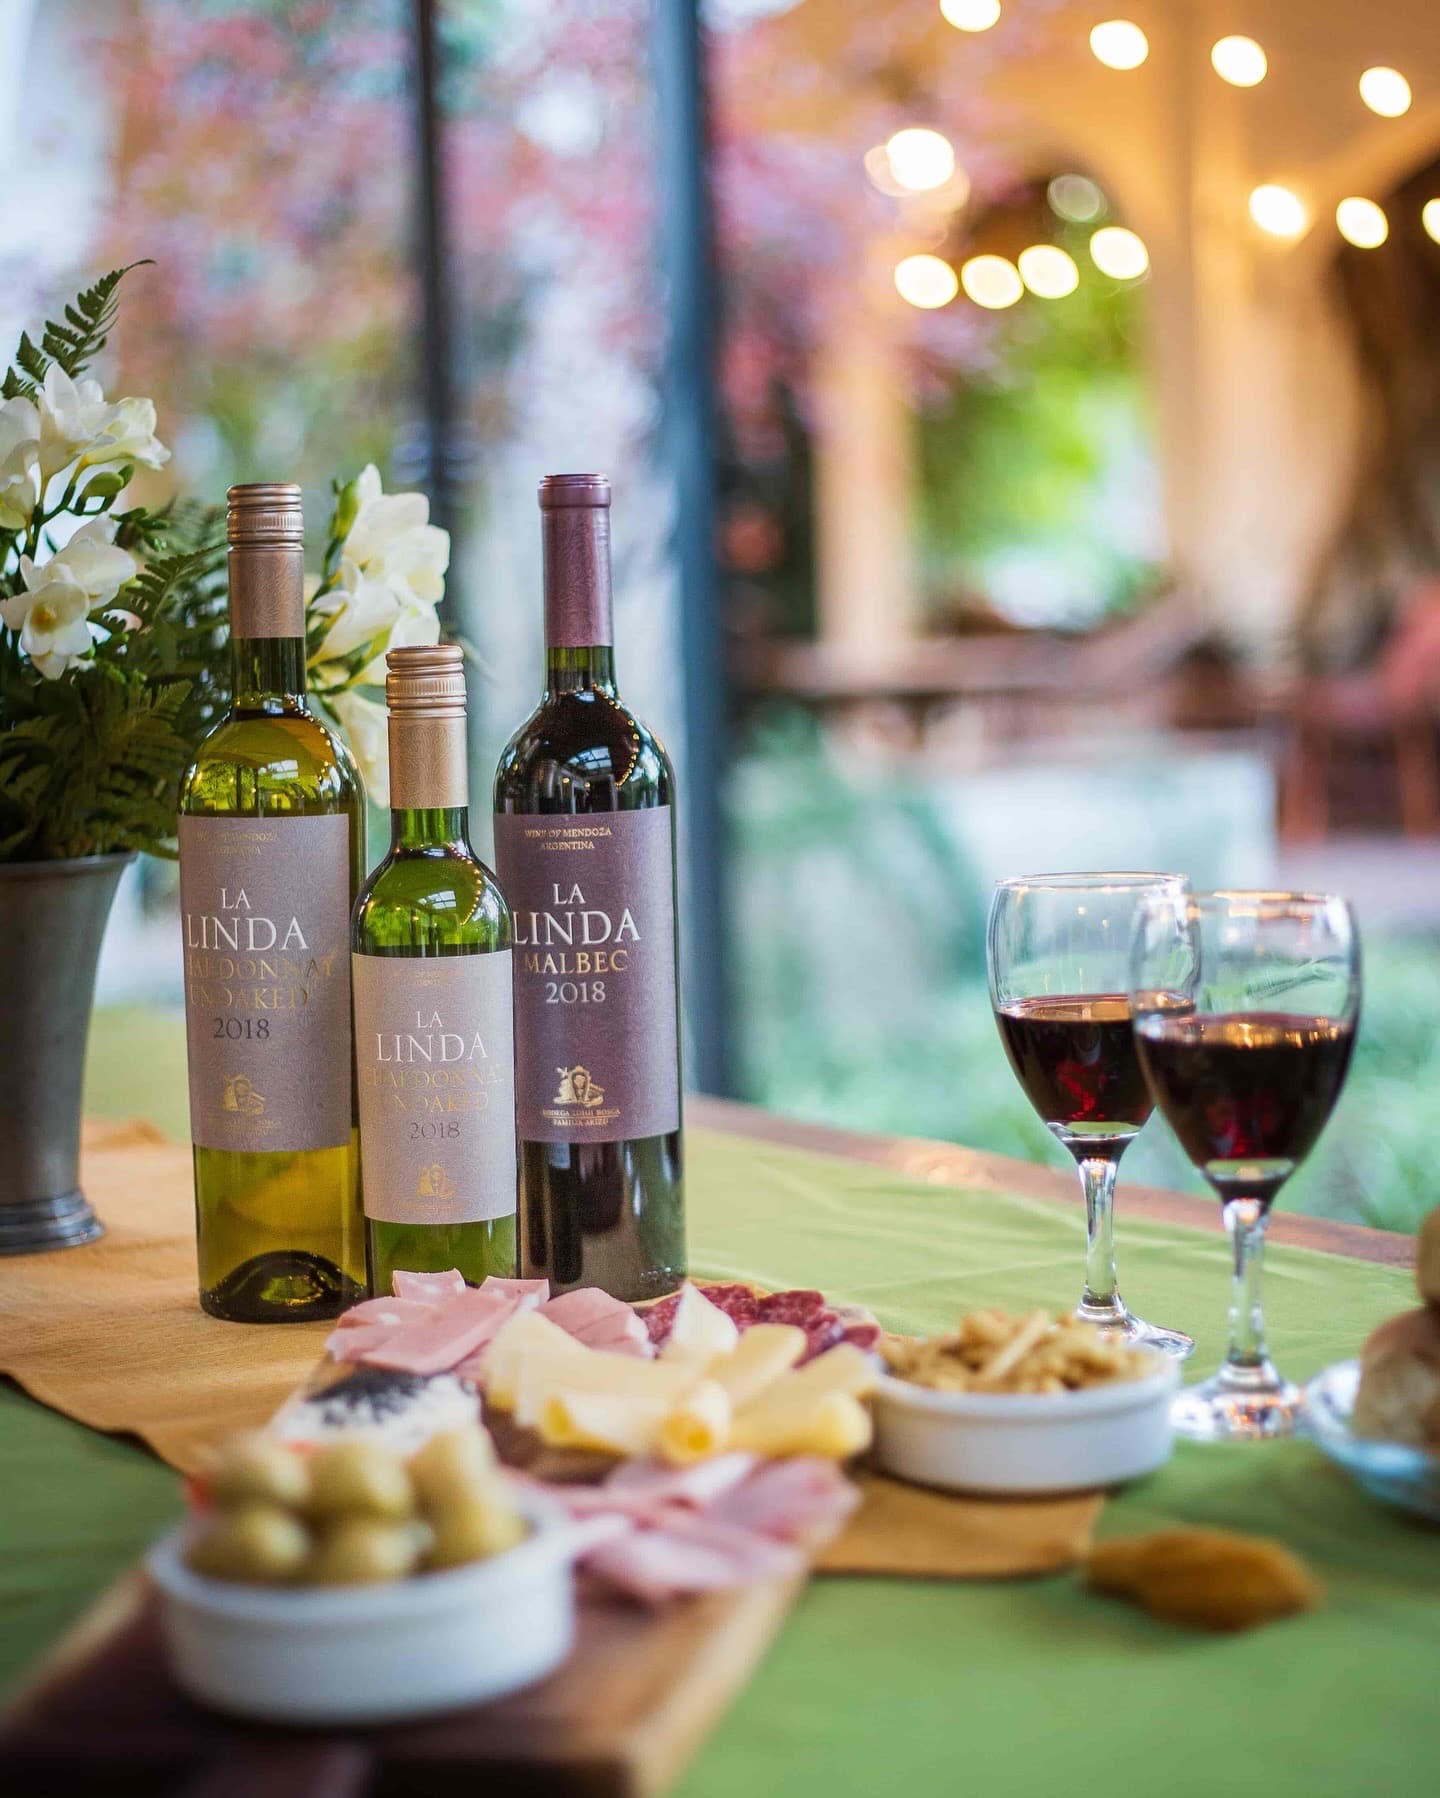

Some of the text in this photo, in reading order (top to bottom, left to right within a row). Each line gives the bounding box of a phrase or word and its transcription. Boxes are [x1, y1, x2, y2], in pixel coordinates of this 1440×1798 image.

[563, 826, 613, 838] MENDOZA
[541, 840, 595, 851] ARGENTINA
[220, 887, 251, 910] LA
[553, 883, 587, 905] LA
[186, 914, 310, 951] LINDA
[512, 907, 642, 946] LINDA
[524, 949, 628, 975] MALBEC
[545, 981, 607, 1004] 2018
[213, 1017, 270, 1040] 2018
[416, 1010, 444, 1029] LA
[375, 1032, 489, 1063] LINDA
[409, 1120, 461, 1140] 2018
